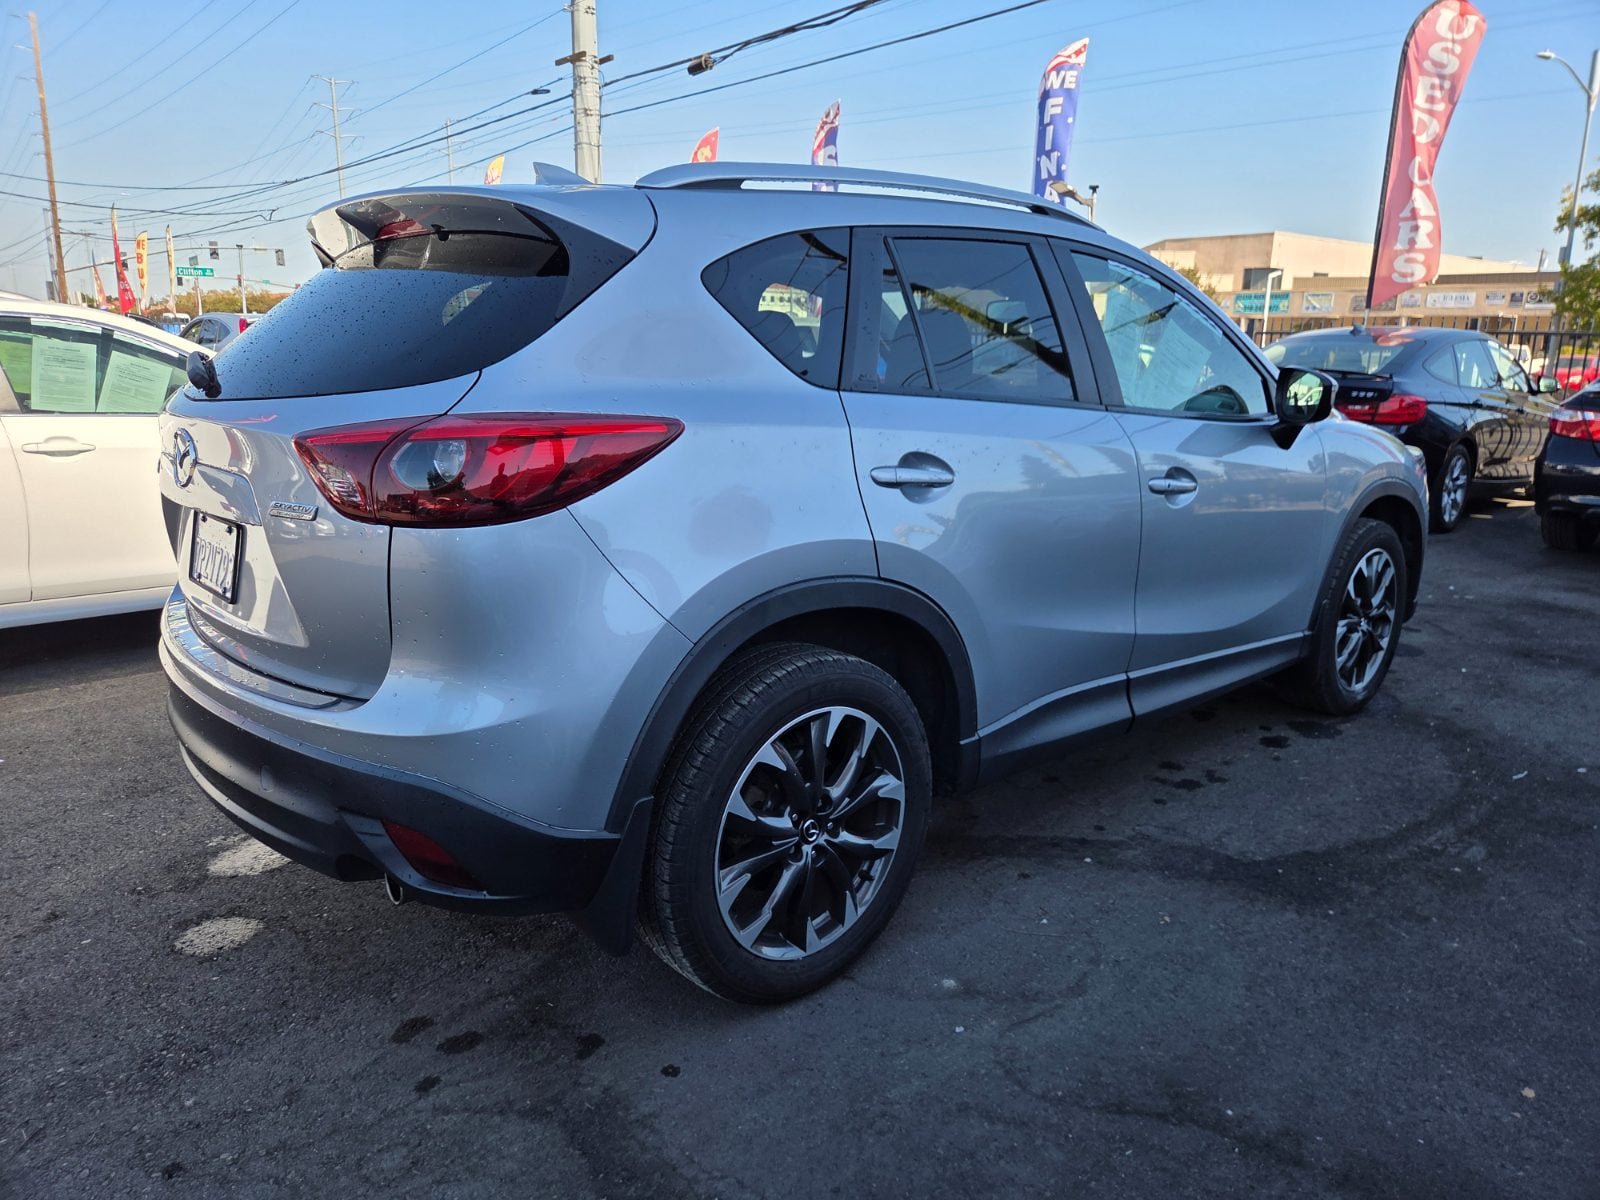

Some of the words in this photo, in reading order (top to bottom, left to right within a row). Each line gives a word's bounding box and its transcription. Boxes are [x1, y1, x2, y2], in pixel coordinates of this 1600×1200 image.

[1046, 70, 1078, 89] WE
[1411, 7, 1479, 144] USED
[1391, 155, 1437, 285] CARS
[178, 267, 202, 276] Clifton
